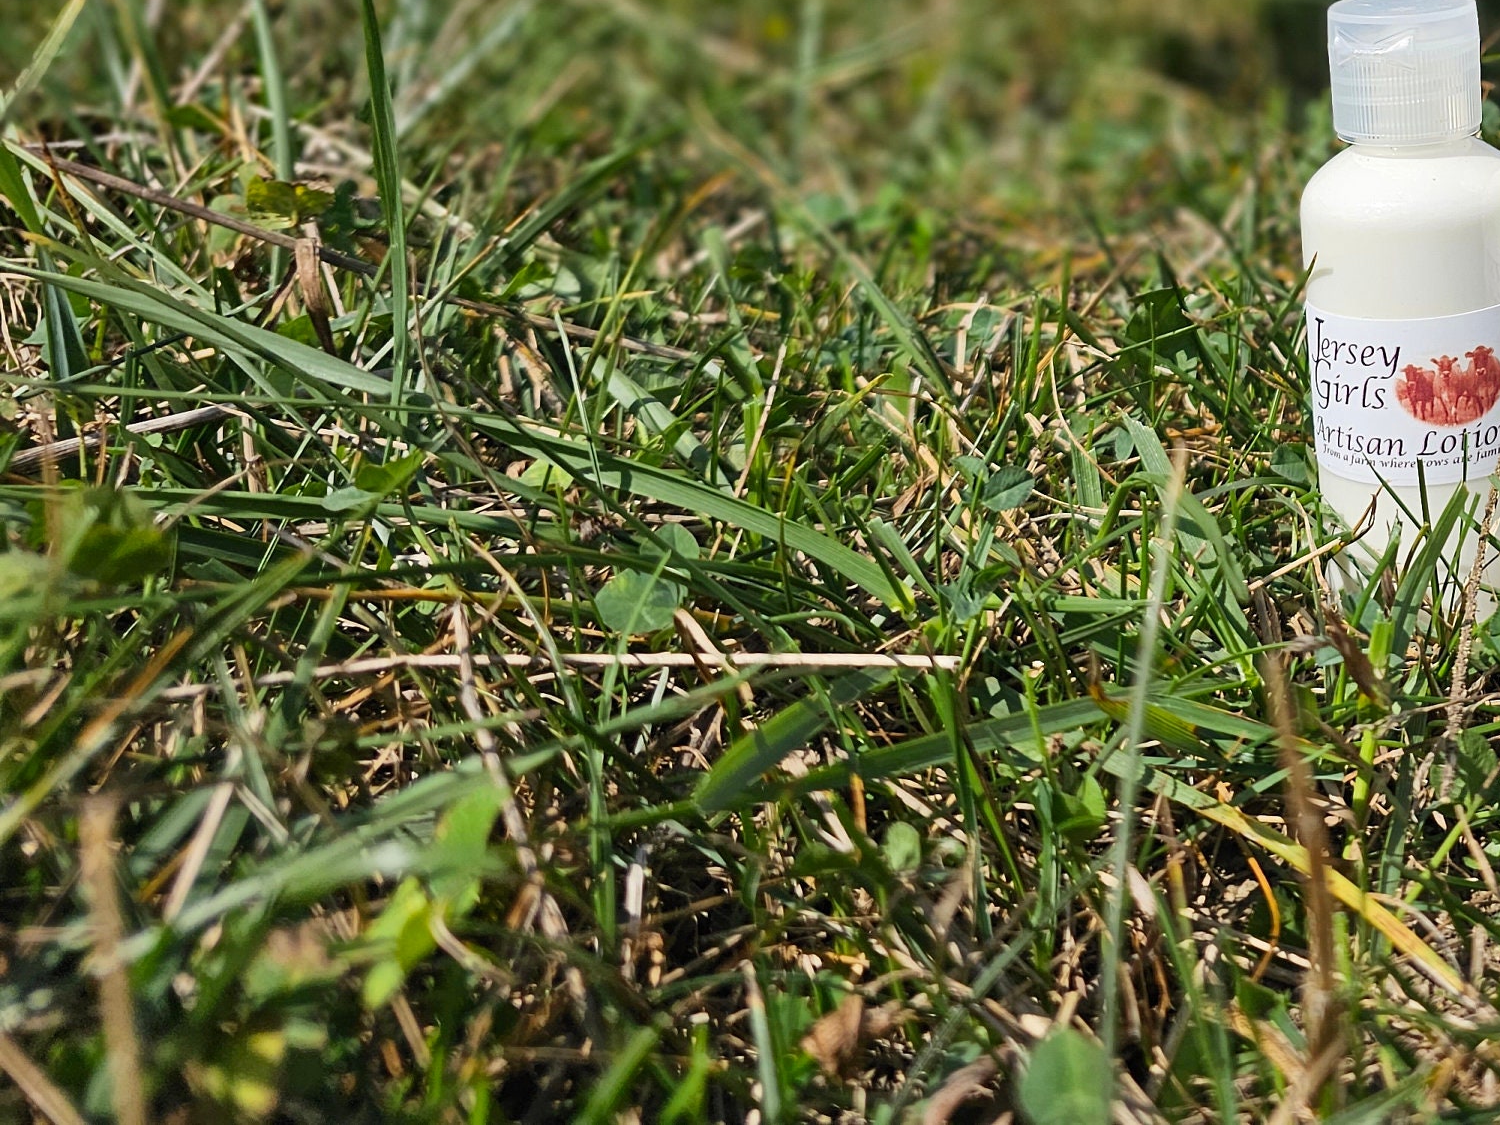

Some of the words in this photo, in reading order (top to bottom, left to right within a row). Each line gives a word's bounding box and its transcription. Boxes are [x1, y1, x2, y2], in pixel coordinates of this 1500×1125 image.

[1312, 317, 1401, 379] Jersey
[1315, 358, 1387, 410] Girls
[1317, 416, 1407, 456] Artisan
[1379, 457, 1416, 468] where
[1422, 458, 1449, 467] ows
[1453, 454, 1473, 465] ae
